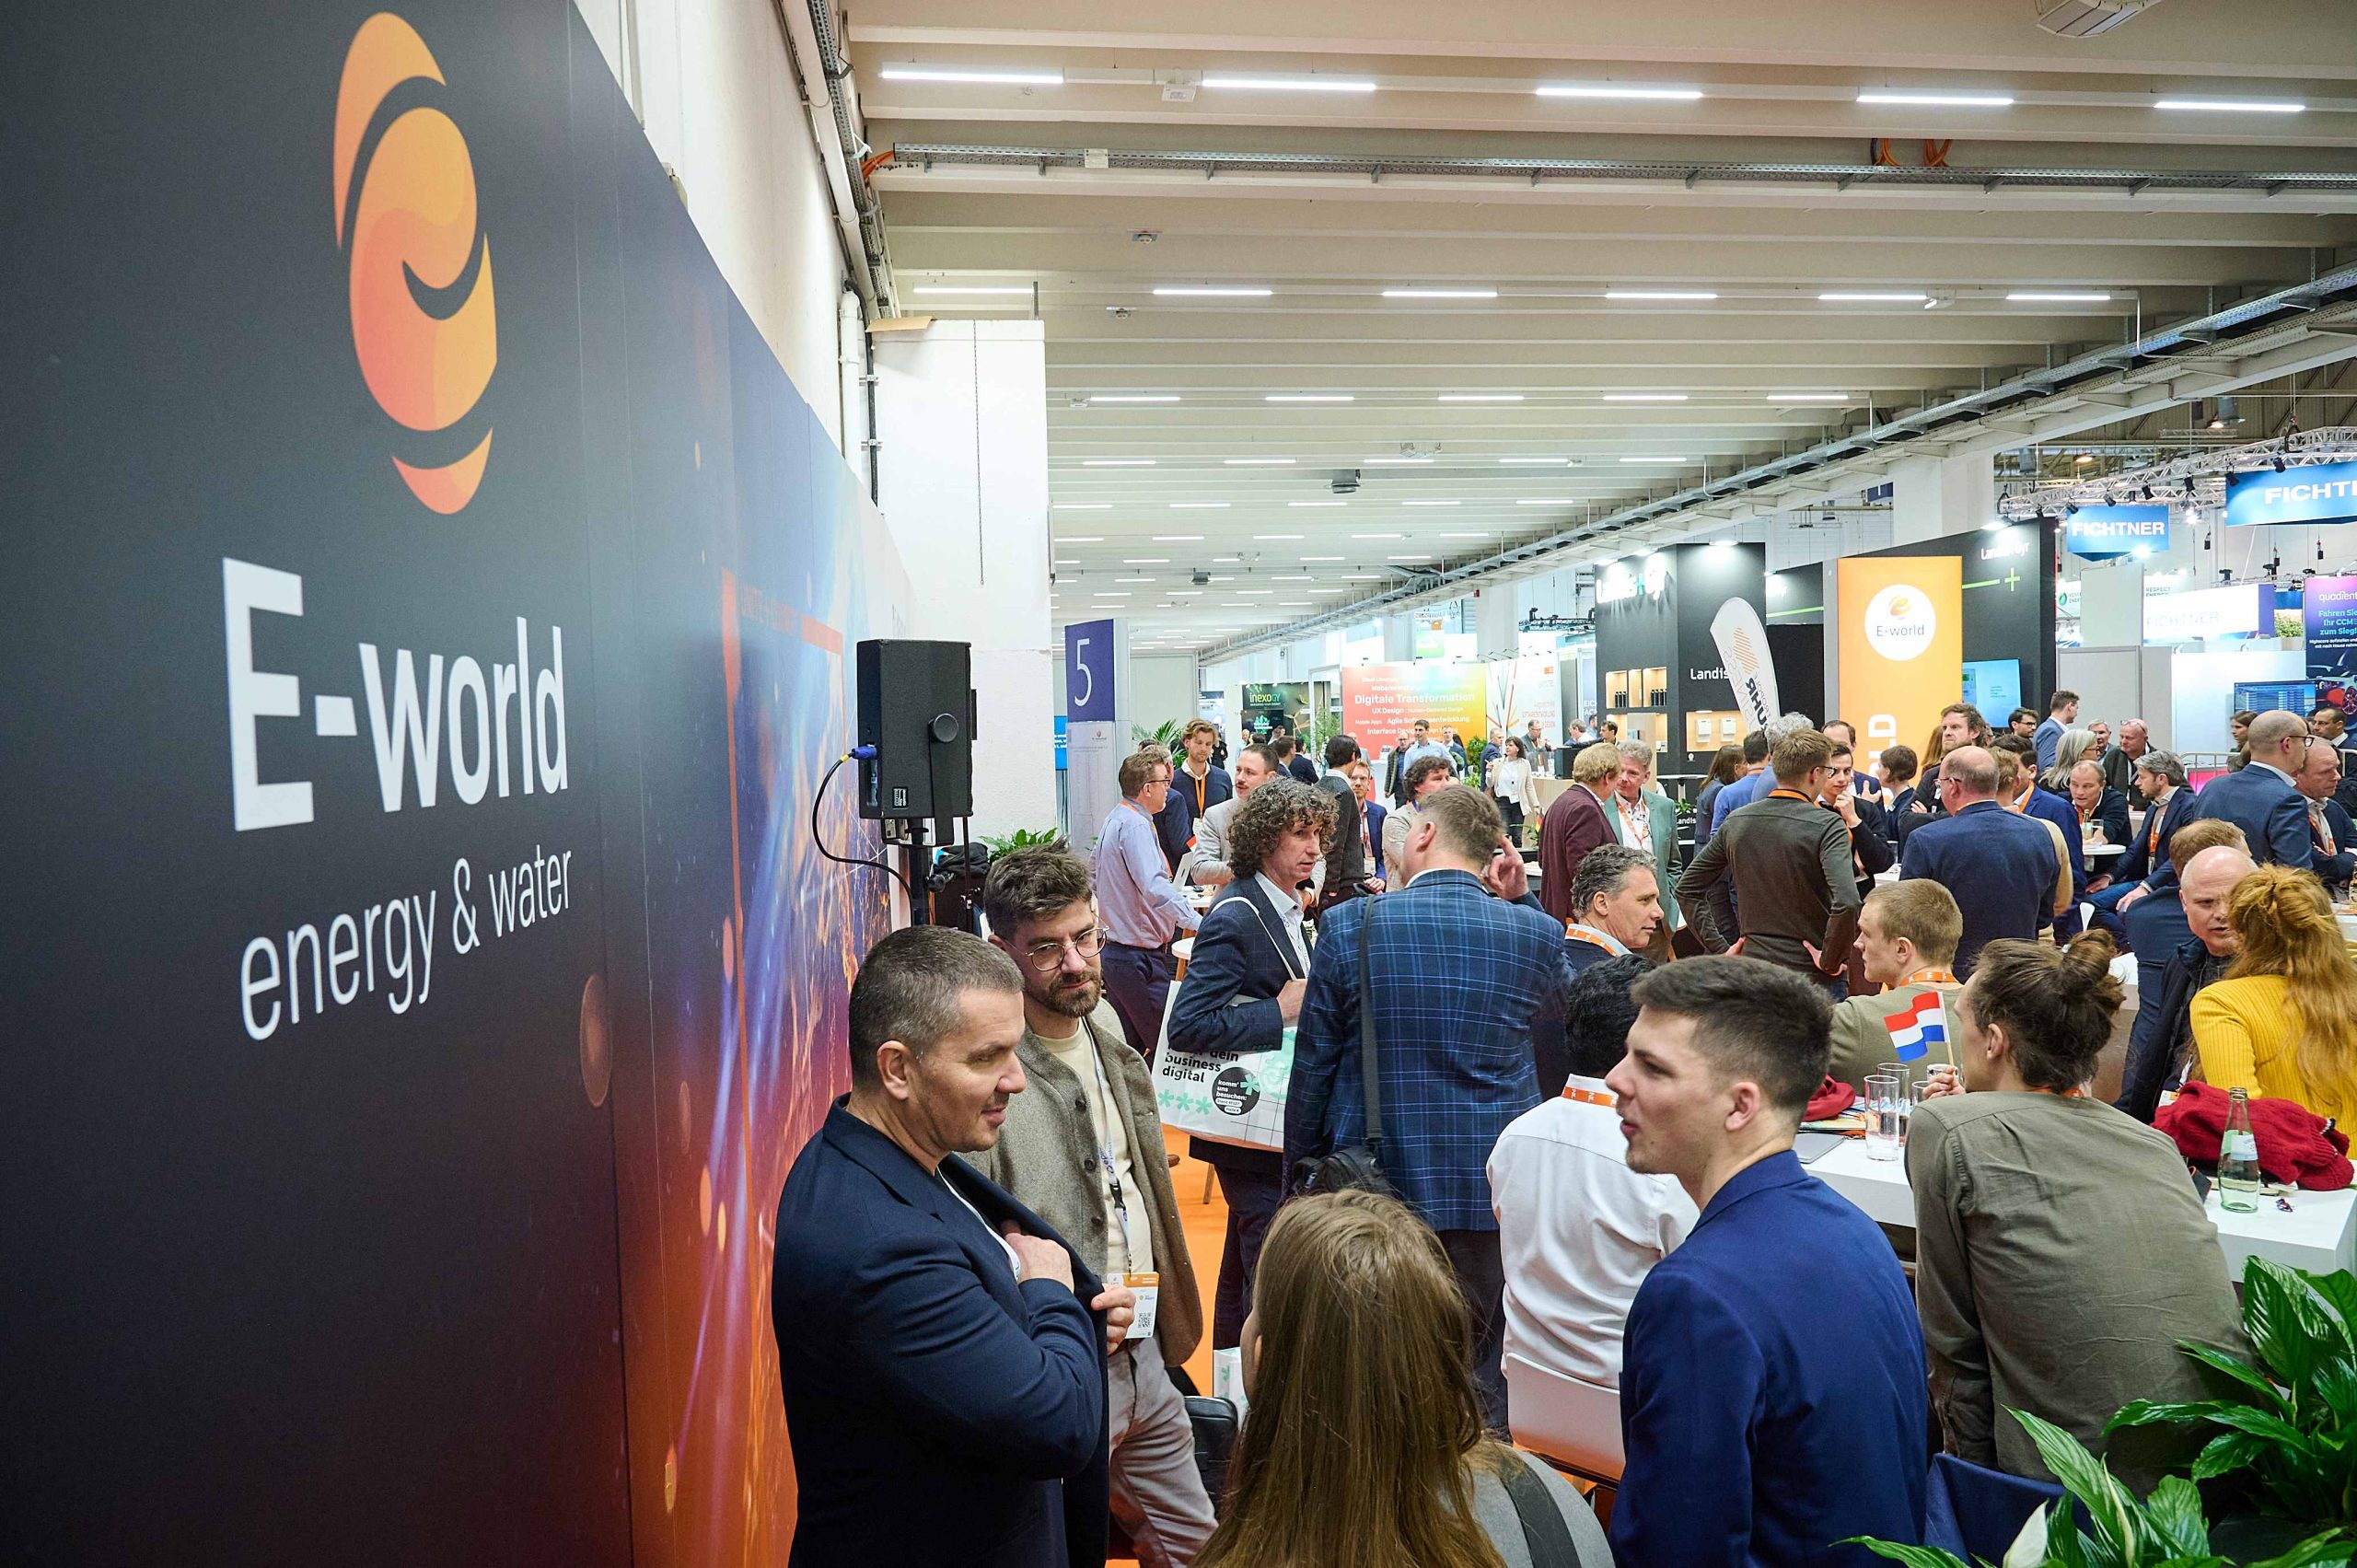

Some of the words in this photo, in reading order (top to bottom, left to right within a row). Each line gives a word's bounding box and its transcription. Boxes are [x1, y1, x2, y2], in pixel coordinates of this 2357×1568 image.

[2264, 480, 2357, 505] FICHT
[2072, 521, 2165, 537] FICHTNER
[1876, 624, 1925, 637] E-world
[1074, 637, 1093, 707] 5
[223, 557, 568, 831] E-world
[1354, 694, 1394, 706] Digitale
[1396, 692, 1475, 704] Transformation
[241, 889, 436, 1041] energy
[452, 858, 481, 954] &
[489, 844, 572, 937] water
[1165, 1052, 1222, 1073] business
[1162, 1065, 1205, 1083] digital
[1215, 1091, 1248, 1101] besuchen:
